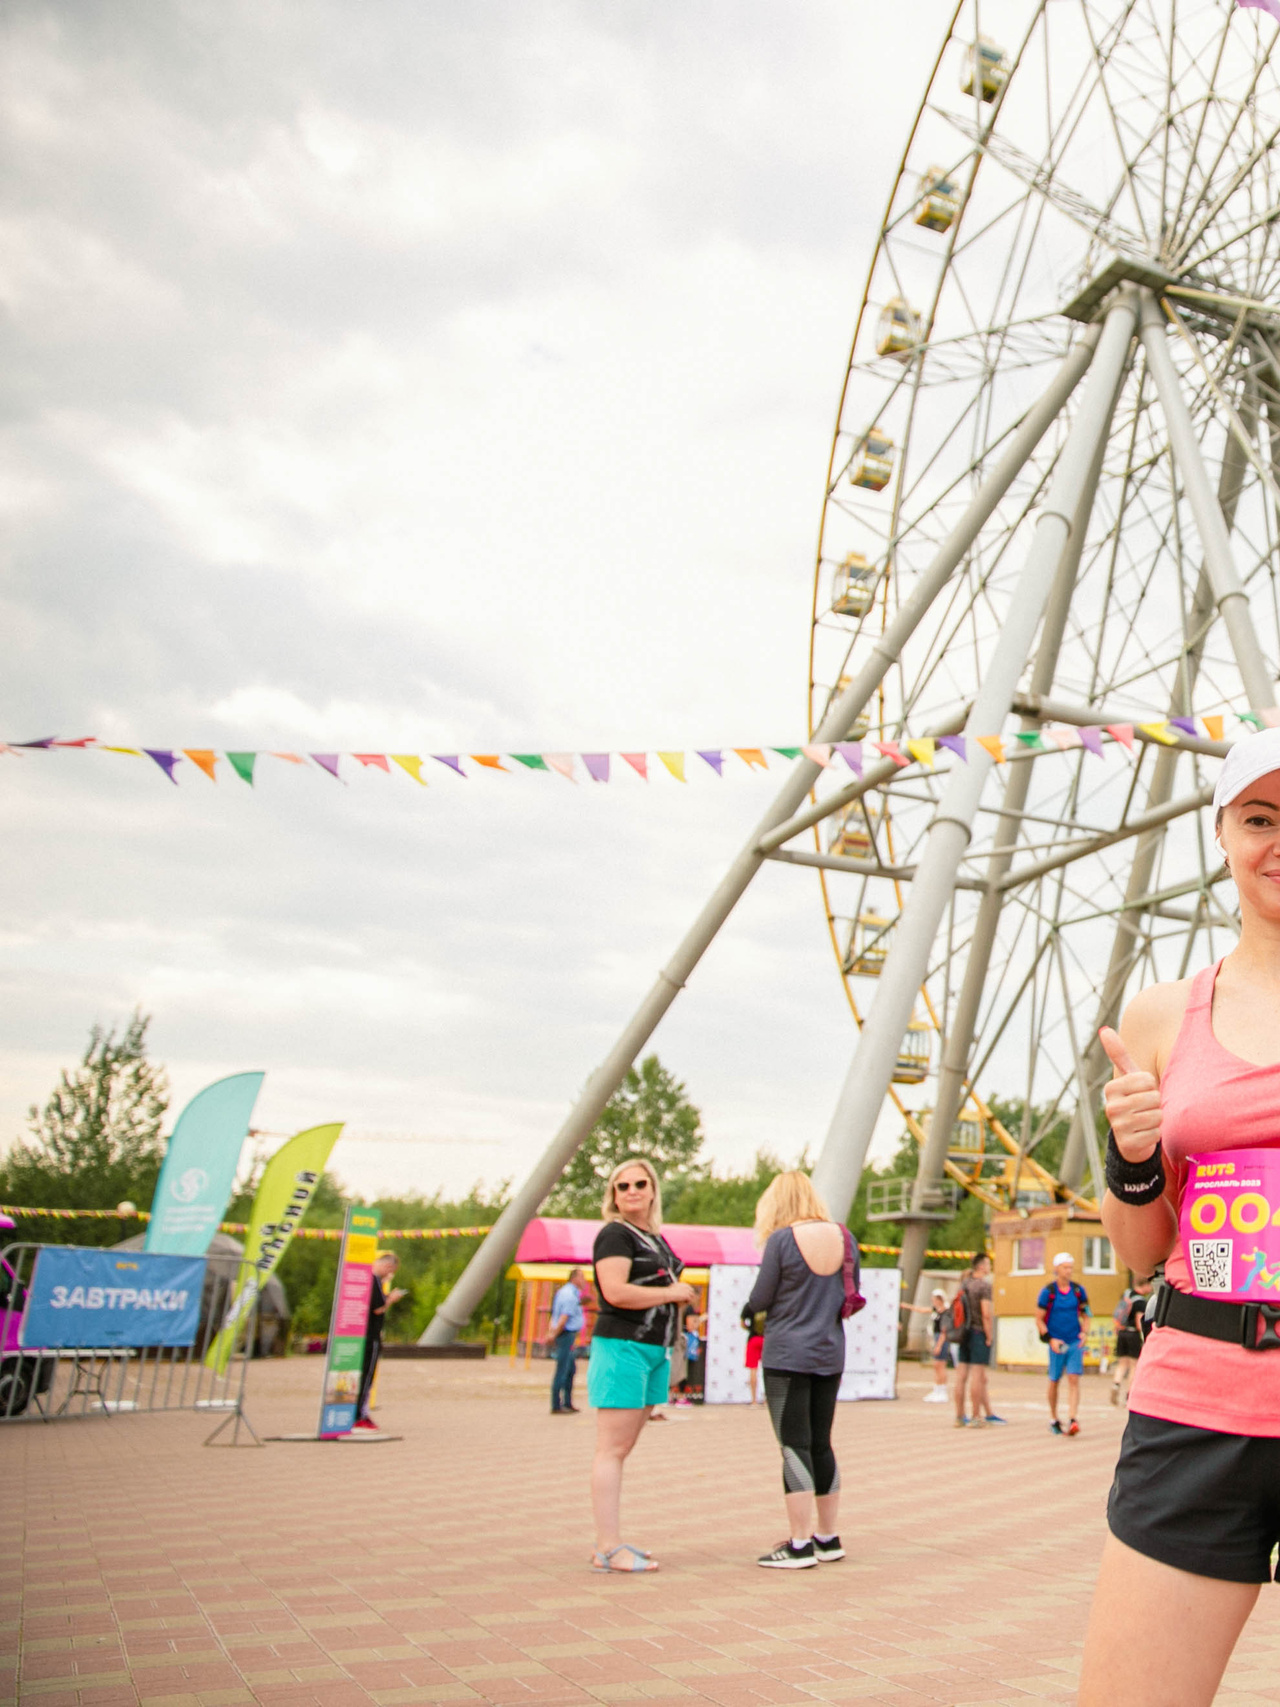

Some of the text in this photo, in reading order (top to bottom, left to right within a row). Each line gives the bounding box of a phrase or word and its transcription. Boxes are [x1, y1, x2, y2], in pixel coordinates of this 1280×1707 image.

[1196, 1162, 1235, 1177] RUTS
[1194, 1180, 1240, 1189] ЯРОСЛАВЛЬ
[50, 1286, 188, 1311] ЗАВТРАКИ
